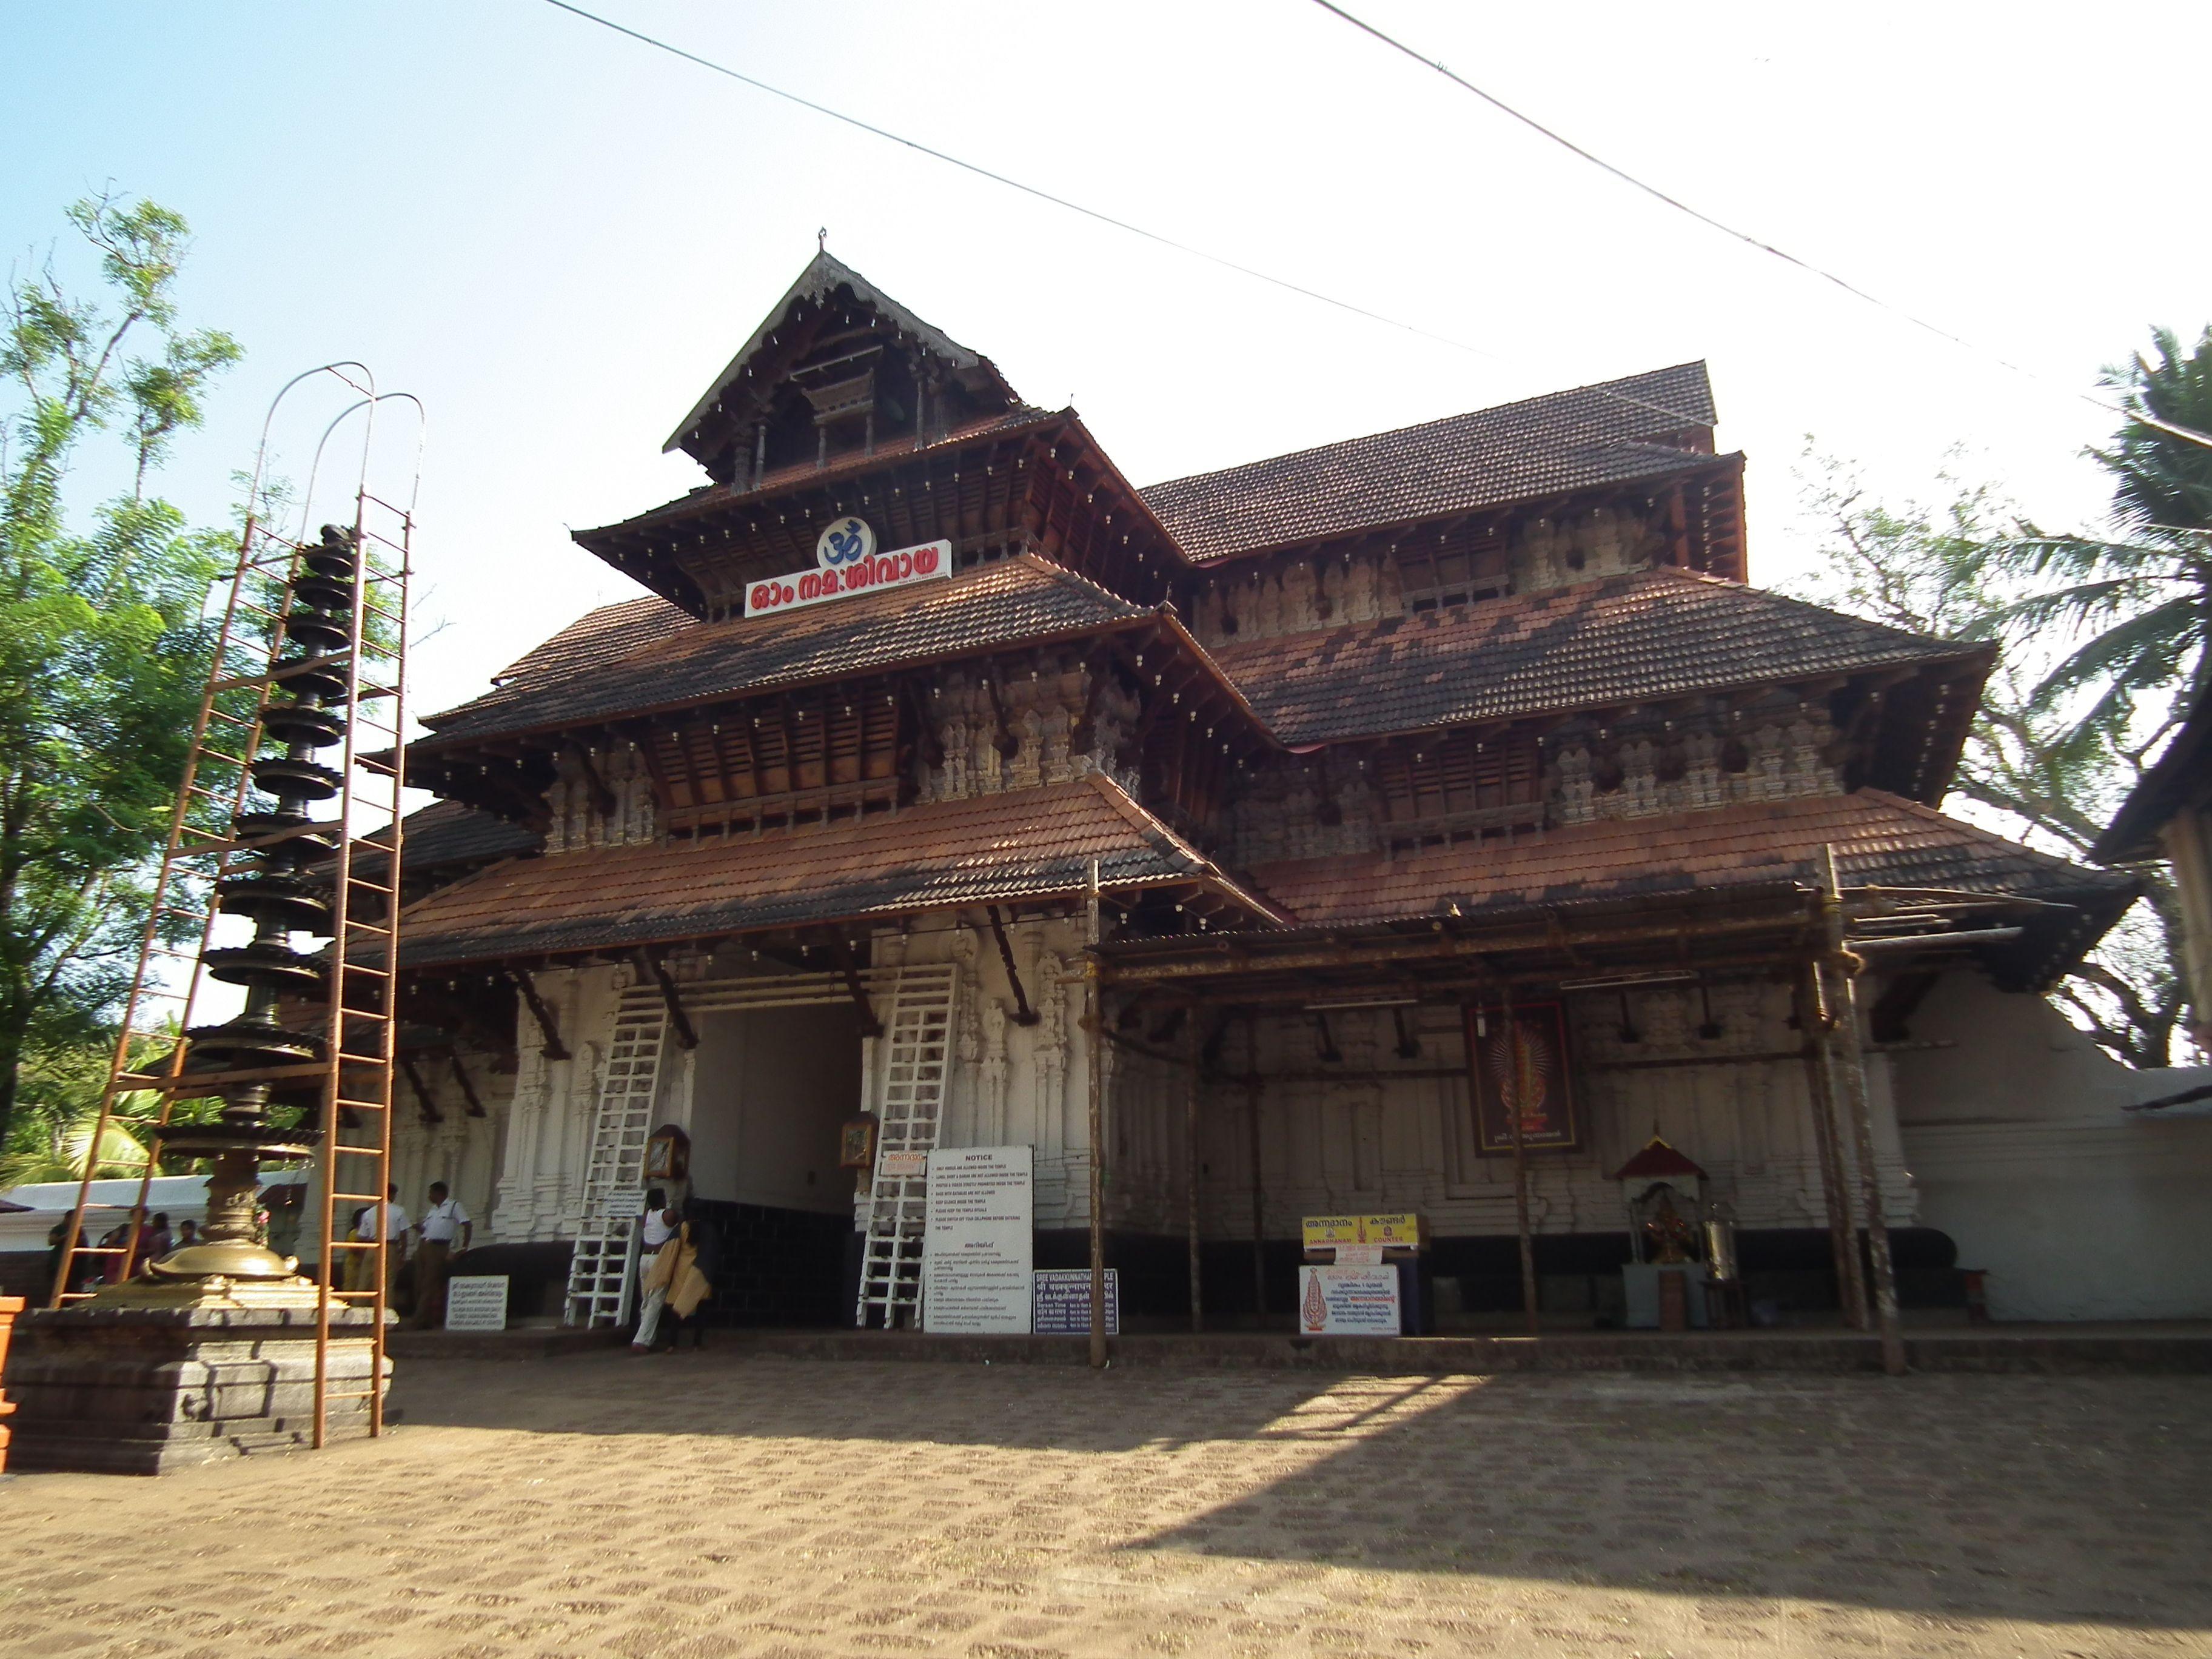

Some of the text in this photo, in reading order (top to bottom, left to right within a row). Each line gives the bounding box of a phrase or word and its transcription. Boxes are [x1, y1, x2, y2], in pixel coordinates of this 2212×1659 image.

[751, 581, 794, 609] ഓം
[1306, 1218, 1352, 1228] അന്നദാനം
[1037, 1282, 1045, 1290] श्री
